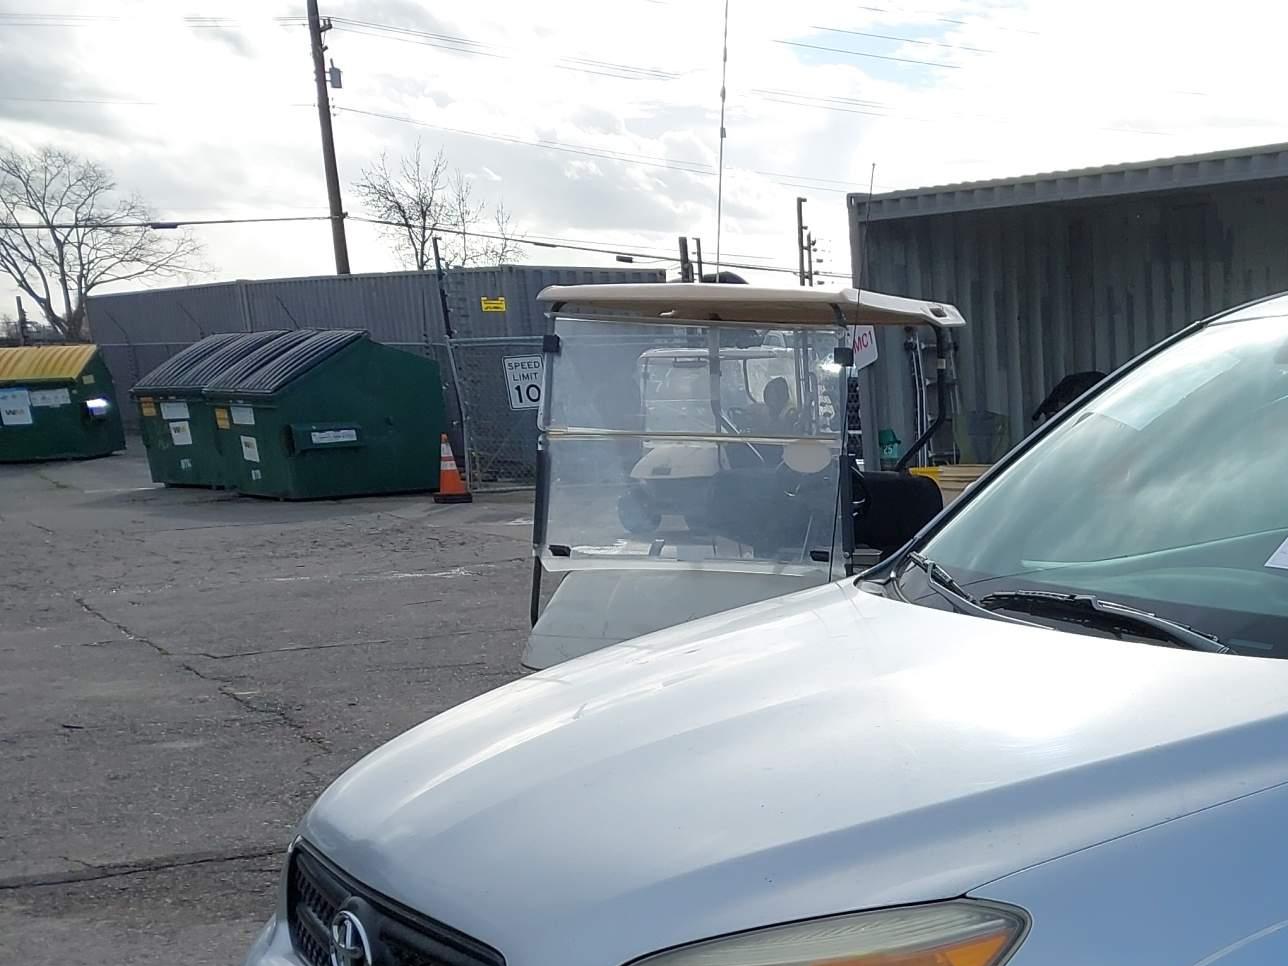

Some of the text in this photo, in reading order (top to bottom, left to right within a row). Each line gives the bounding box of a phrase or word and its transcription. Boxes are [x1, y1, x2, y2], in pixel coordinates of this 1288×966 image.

[507, 361, 540, 370] SPEED
[512, 372, 538, 382] LIMIT
[514, 384, 541, 403] 10
